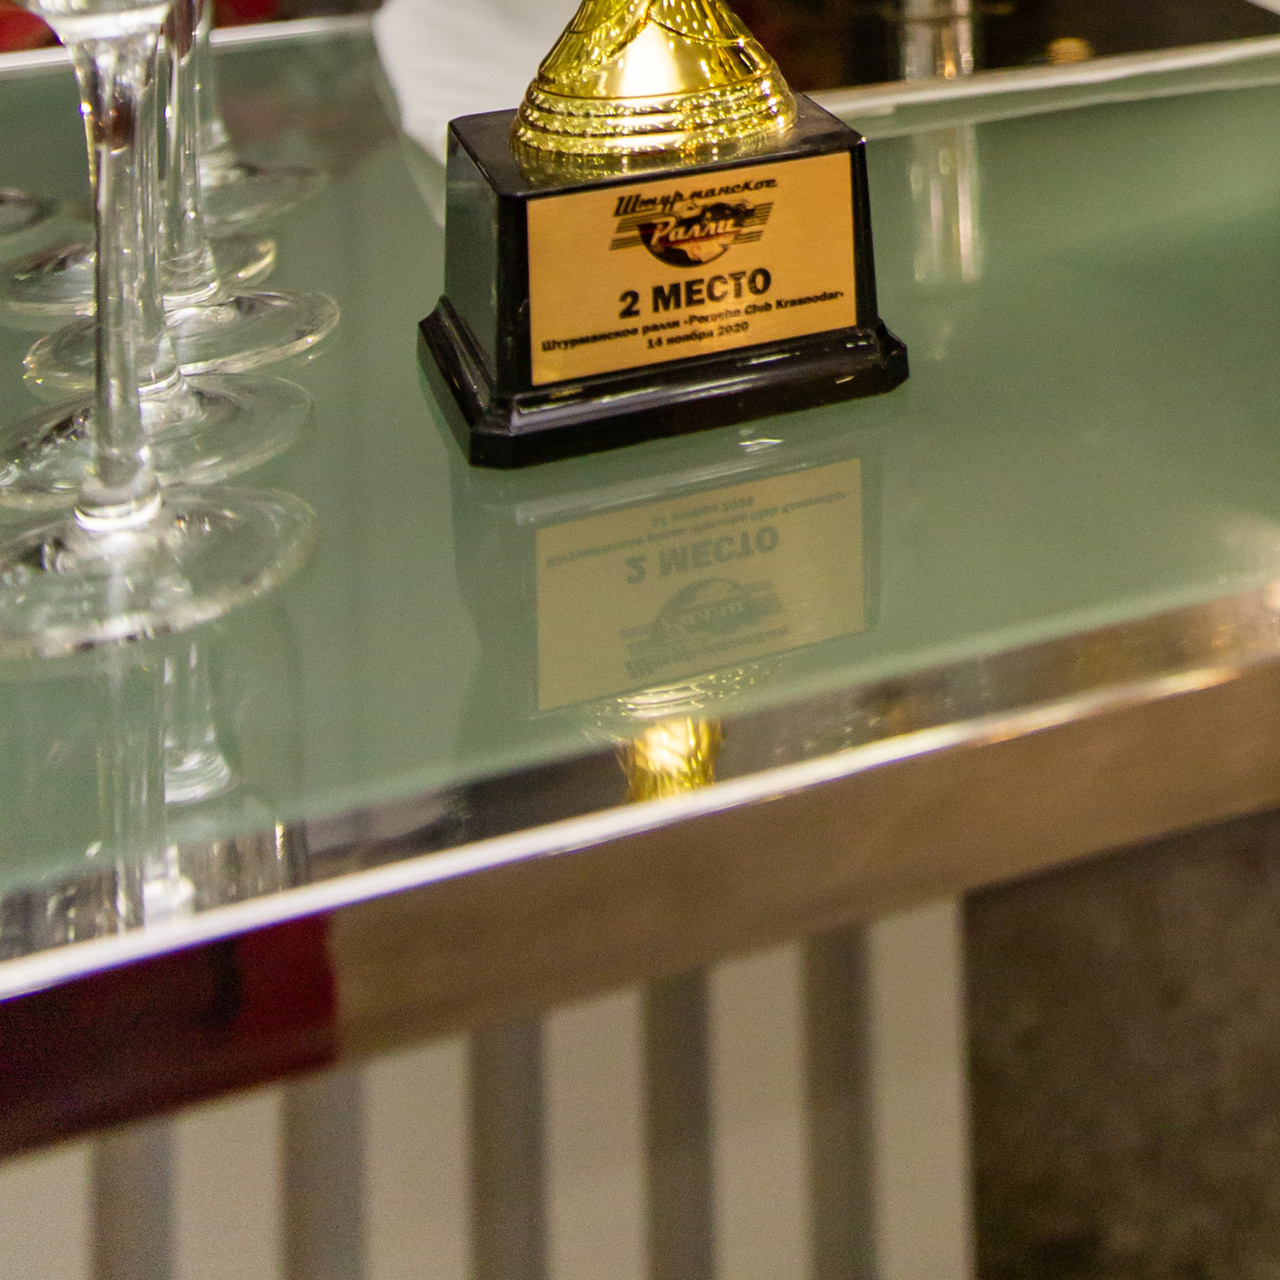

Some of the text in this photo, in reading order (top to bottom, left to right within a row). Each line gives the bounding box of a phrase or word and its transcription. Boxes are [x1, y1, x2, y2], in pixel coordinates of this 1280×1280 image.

[613, 178, 779, 217] Штурманское
[649, 214, 737, 247] Ралли
[619, 267, 773, 319] 2 МЕСТО
[744, 302, 772, 315] Club
[647, 336, 663, 349] 14
[717, 320, 749, 336] 2020
